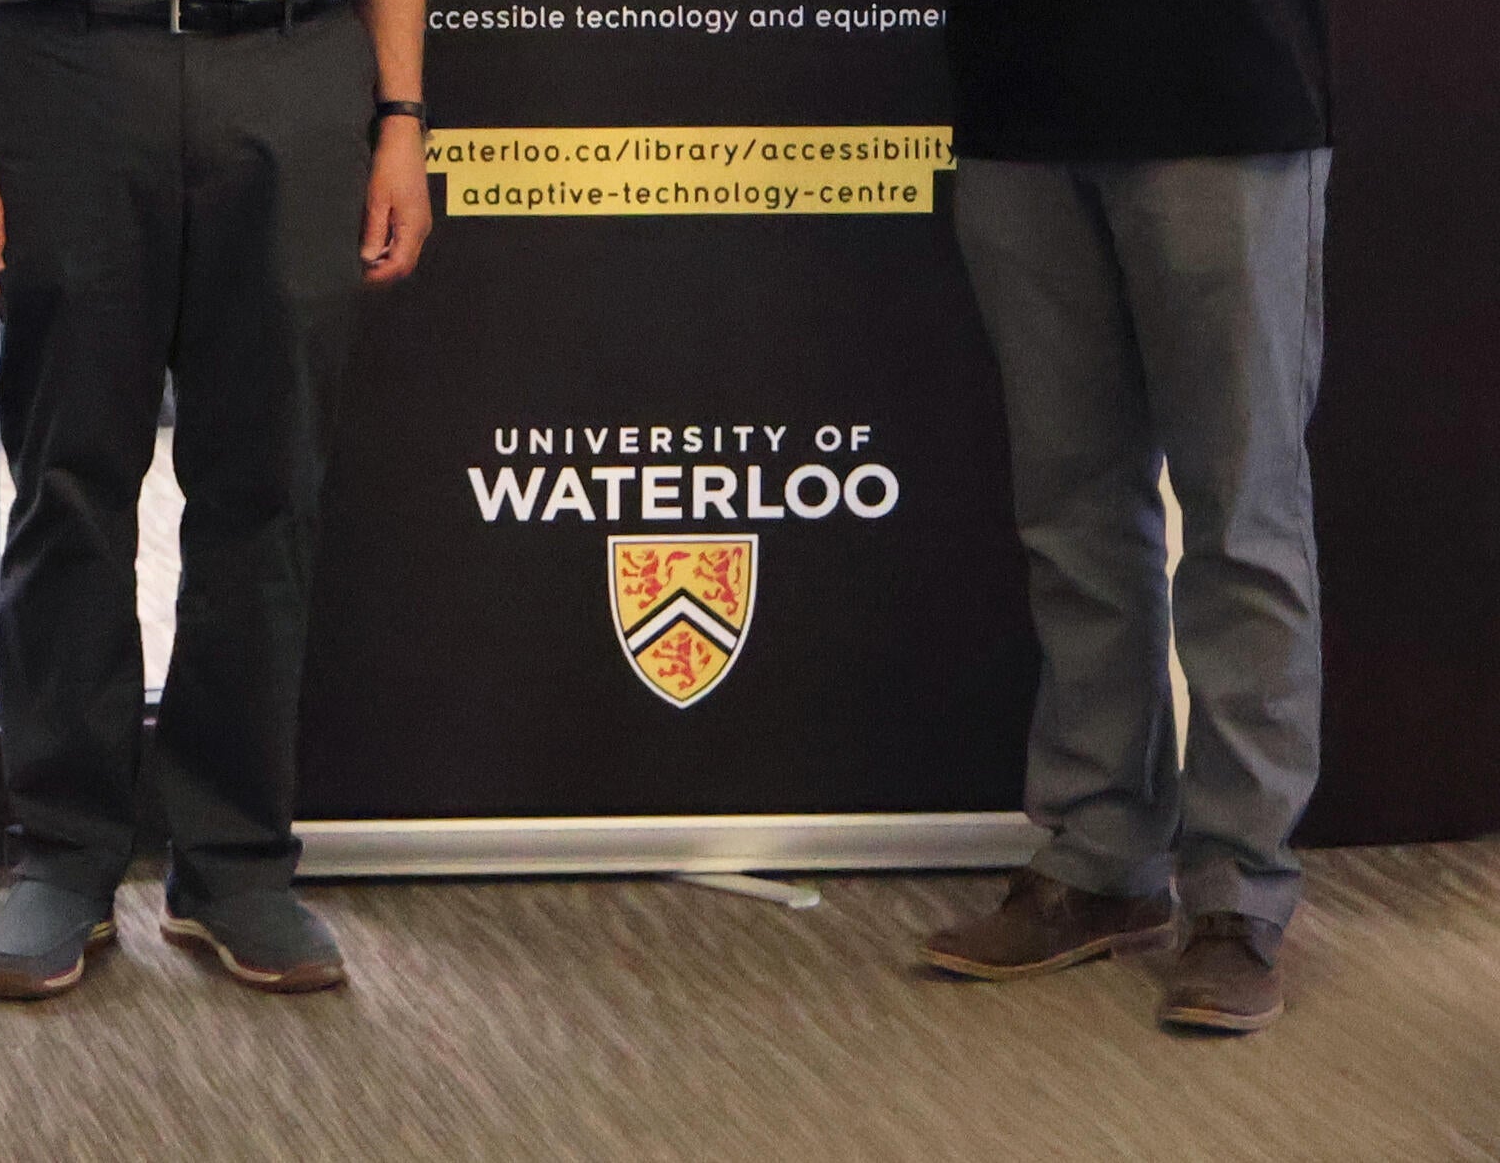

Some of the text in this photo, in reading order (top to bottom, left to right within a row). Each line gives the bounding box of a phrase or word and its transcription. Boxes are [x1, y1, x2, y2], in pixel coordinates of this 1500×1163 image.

[429, 3, 946, 34] ccessible technology and equipme
[426, 136, 955, 165] waterloo.ca/library/accessibility
[462, 180, 918, 209] adaptive-technology-centre
[494, 425, 871, 455] UNIVERSITY OF
[467, 463, 900, 522] WATERLOO
